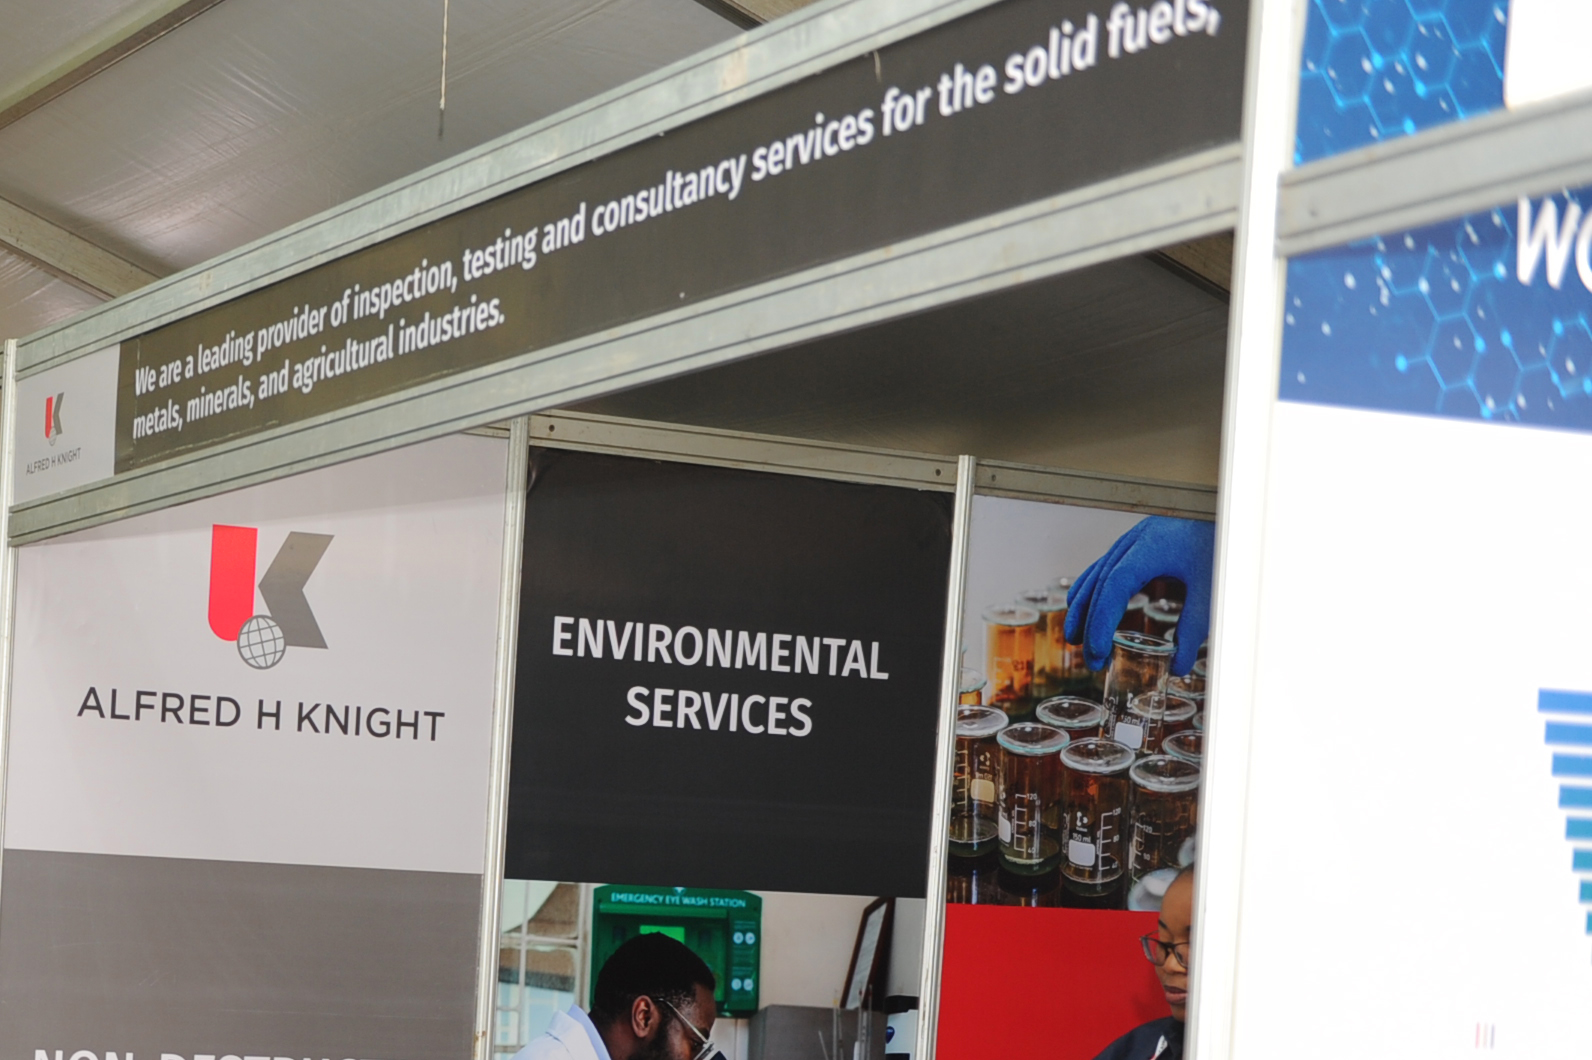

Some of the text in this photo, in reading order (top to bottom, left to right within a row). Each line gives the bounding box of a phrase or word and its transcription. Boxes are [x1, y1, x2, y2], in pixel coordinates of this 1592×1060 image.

[136, 0, 1221, 396] We are a leading provider of inspection, testing and consultancy services for the solid fuels,
[133, 294, 505, 440] metals, minerals, and agricultural industries.
[26, 447, 81, 476] ALFRED H KNIGHT
[552, 615, 889, 680] ENVIRONMENTAL
[76, 687, 446, 742] ALFRED H KNIGHT
[625, 685, 813, 737] SERVICES
[611, 892, 746, 908] EMERGENCY EYE WASH STATION
